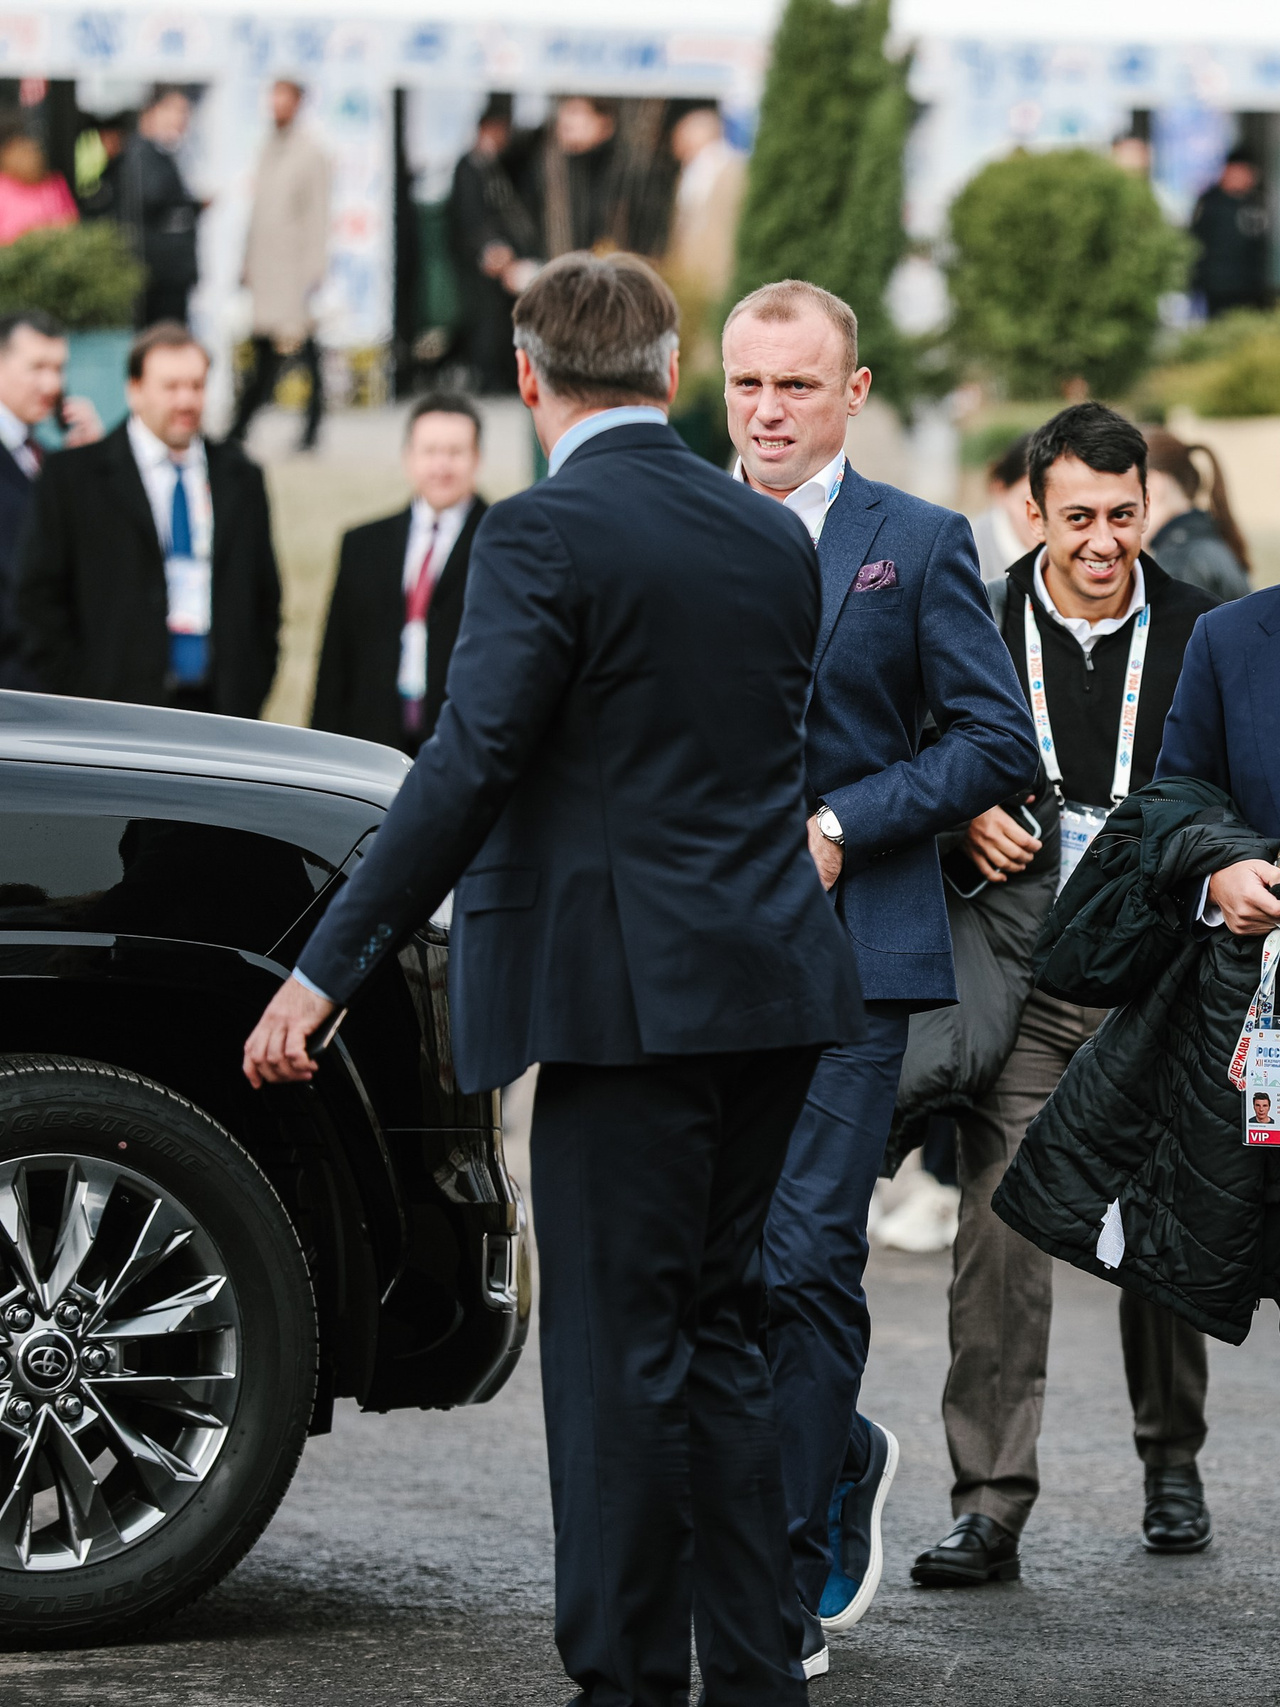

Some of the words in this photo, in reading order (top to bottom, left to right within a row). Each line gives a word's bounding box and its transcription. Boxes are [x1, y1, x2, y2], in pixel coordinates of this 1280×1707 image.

[1123, 704, 1136, 726] 2024
[1230, 1037, 1251, 1078] ДЕРЖАВА
[1250, 1131, 1270, 1142] VIP
